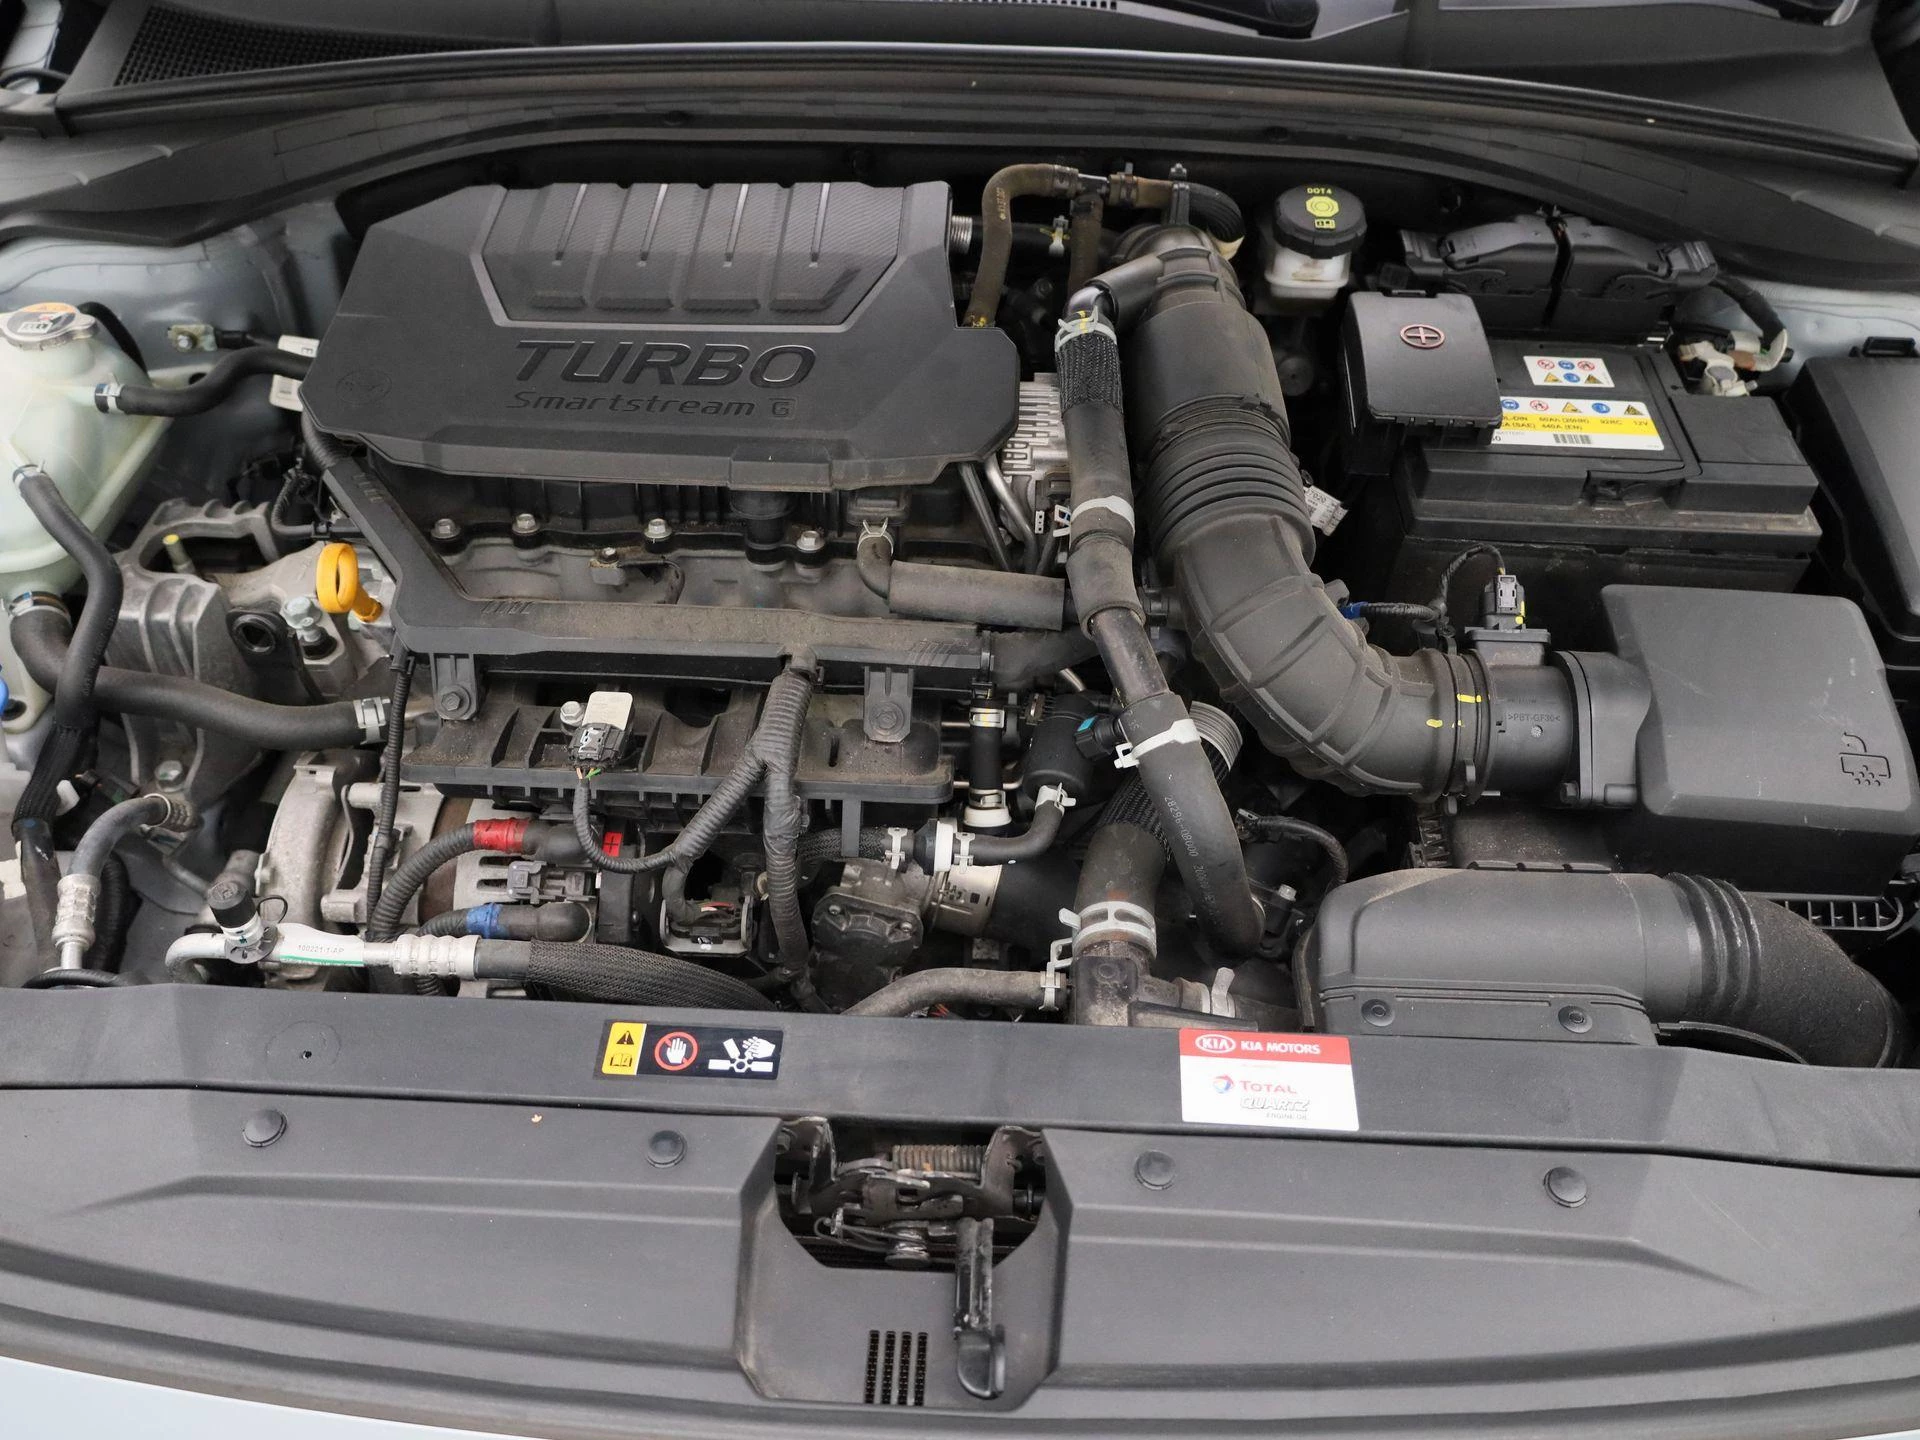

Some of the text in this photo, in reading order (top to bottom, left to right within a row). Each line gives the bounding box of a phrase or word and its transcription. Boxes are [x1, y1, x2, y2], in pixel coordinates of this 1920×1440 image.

[516, 339, 817, 389] TURBO
[505, 391, 756, 417] Smartstream
[1202, 1038, 1321, 1055] KIA KIA MOTORS
[1239, 1080, 1298, 1094] TOTAL
[1239, 1097, 1311, 1112] QUARTZ
